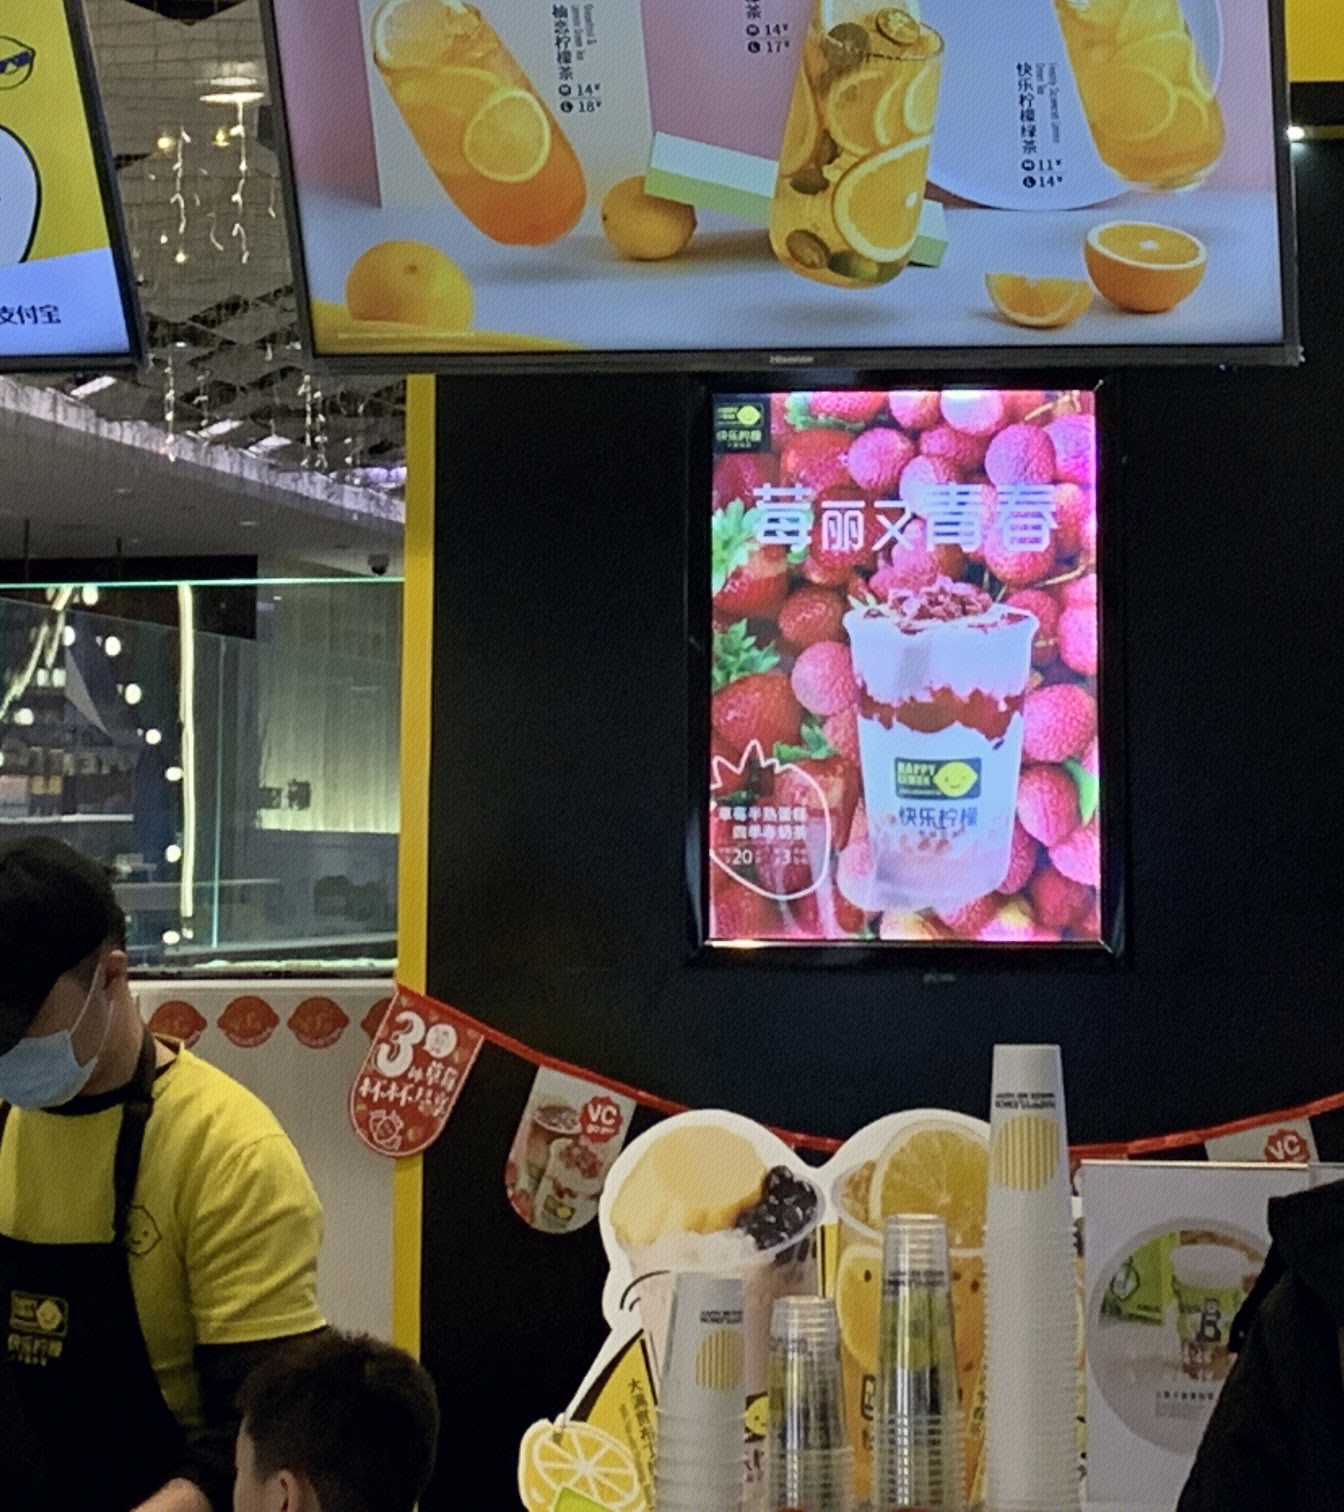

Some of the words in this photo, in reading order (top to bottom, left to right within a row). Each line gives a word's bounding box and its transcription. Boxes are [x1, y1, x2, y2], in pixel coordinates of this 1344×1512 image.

[1017, 62, 1037, 155] 快乐柠檬绿茶
[899, 806, 978, 830] 快乐柠檬
[588, 1103, 618, 1125] VC
[1268, 1135, 1301, 1160] VC
